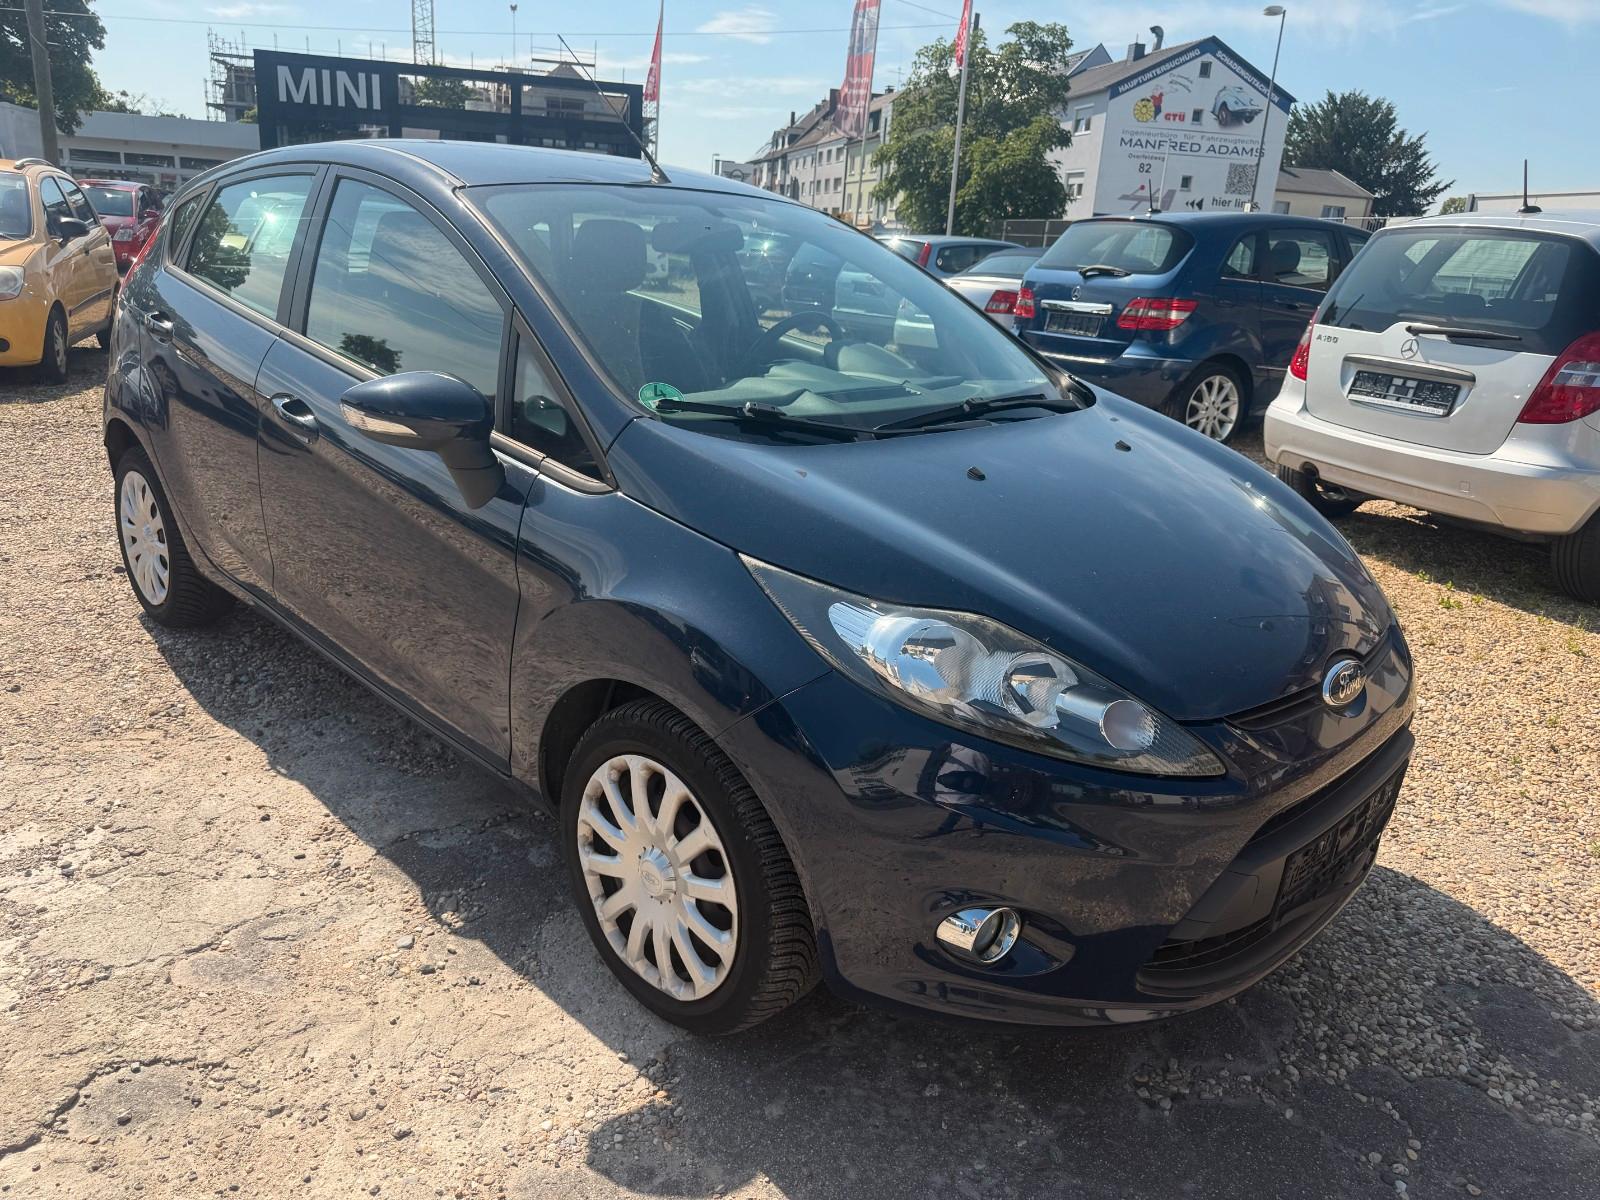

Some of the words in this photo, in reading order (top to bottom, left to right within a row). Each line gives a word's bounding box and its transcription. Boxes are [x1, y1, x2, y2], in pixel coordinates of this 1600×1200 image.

[1118, 48, 1201, 93] HAUPTUNTERSUCHUNG
[277, 65, 381, 110] MINI
[1119, 137, 1201, 153] MANFRED
[1206, 144, 1265, 158] ADAMS
[1138, 162, 1152, 173] 82
[1211, 197, 1232, 207] hier
[1339, 668, 1362, 699] Ford
